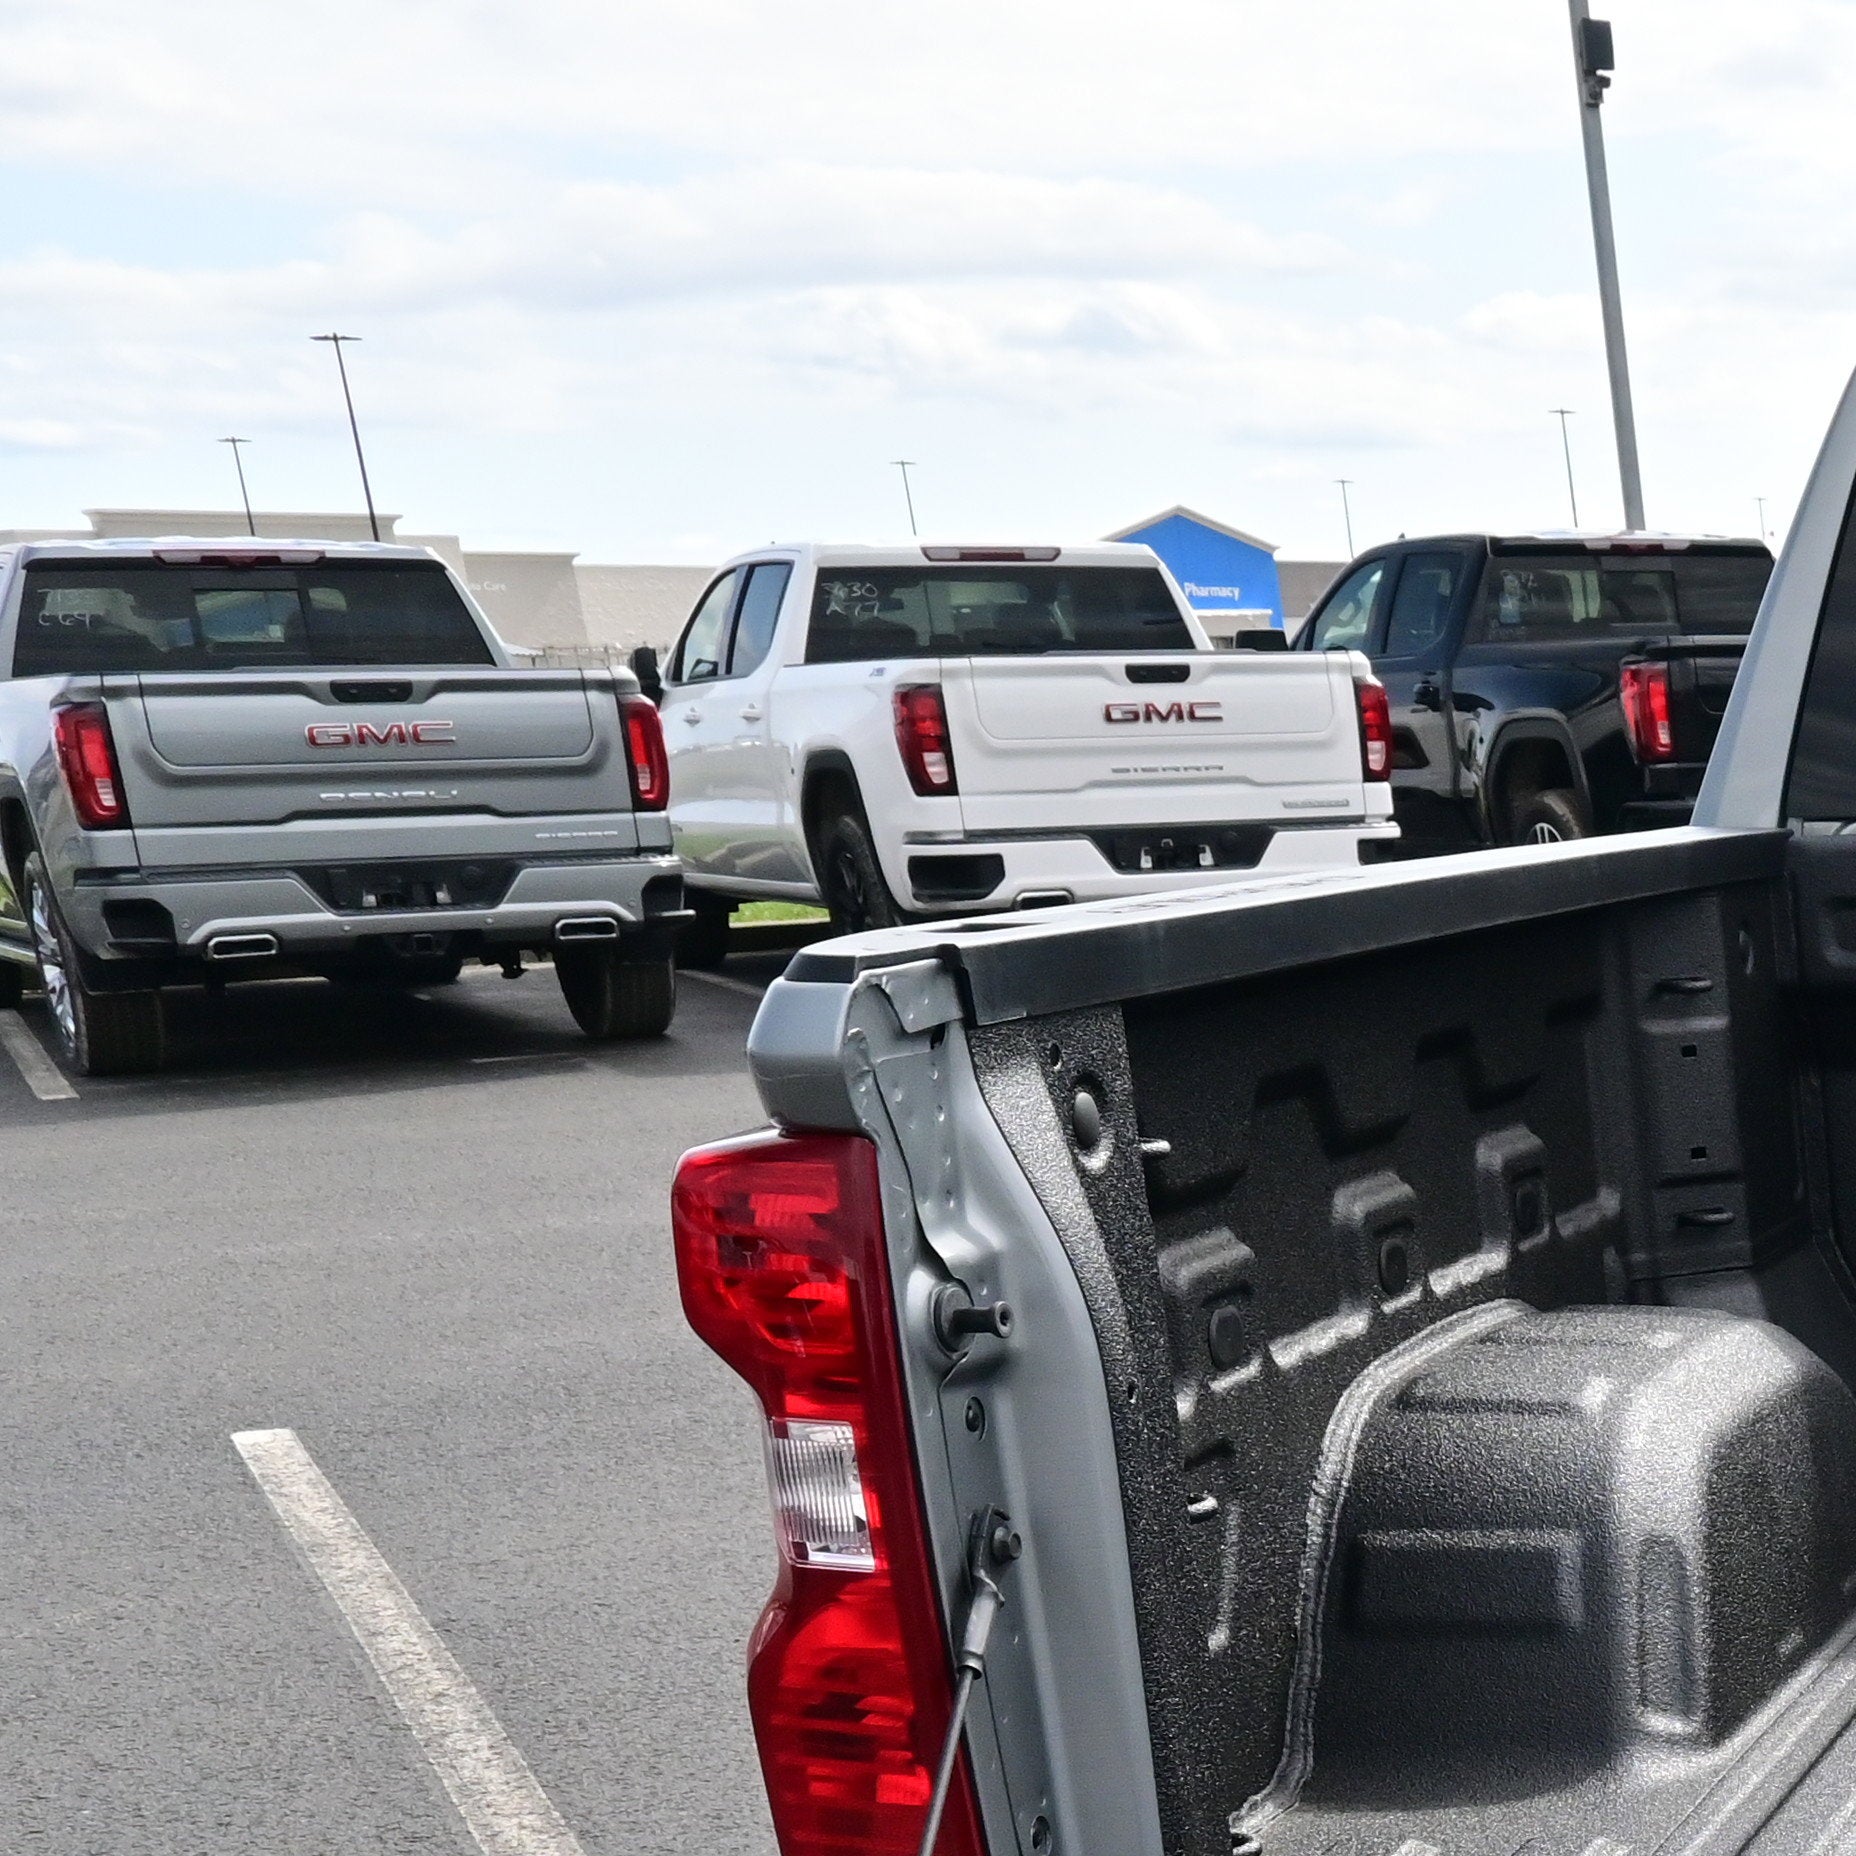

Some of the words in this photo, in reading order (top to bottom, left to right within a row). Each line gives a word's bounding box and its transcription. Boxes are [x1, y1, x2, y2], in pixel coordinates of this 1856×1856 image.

[1183, 581, 1240, 601] Pharmacy
[1103, 701, 1224, 724] GMC
[305, 720, 457, 748] GMC
